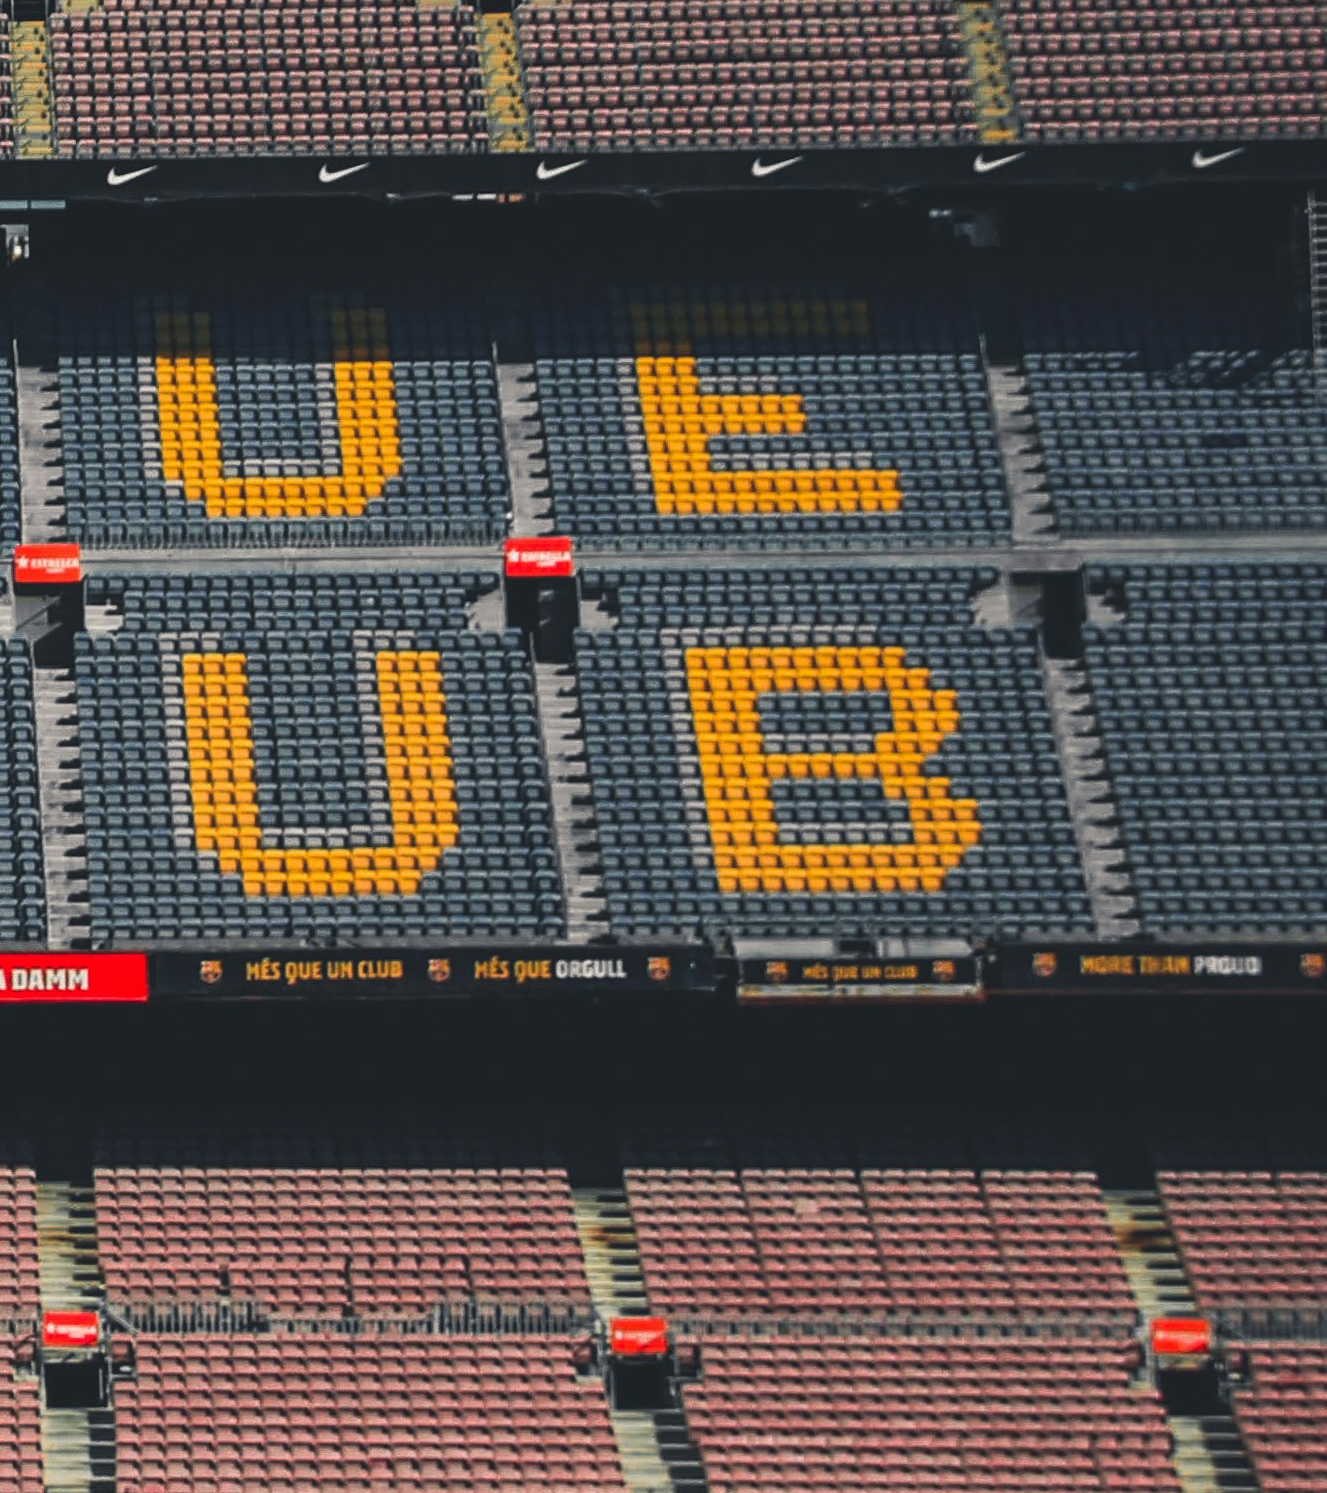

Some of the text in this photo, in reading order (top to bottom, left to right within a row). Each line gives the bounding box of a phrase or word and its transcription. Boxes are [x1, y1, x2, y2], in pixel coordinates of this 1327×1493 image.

[11, 967, 89, 991] DAMM
[246, 958, 403, 986] MÉS QUE UN CLUB
[474, 956, 627, 984] MÉS QUE ORGULL
